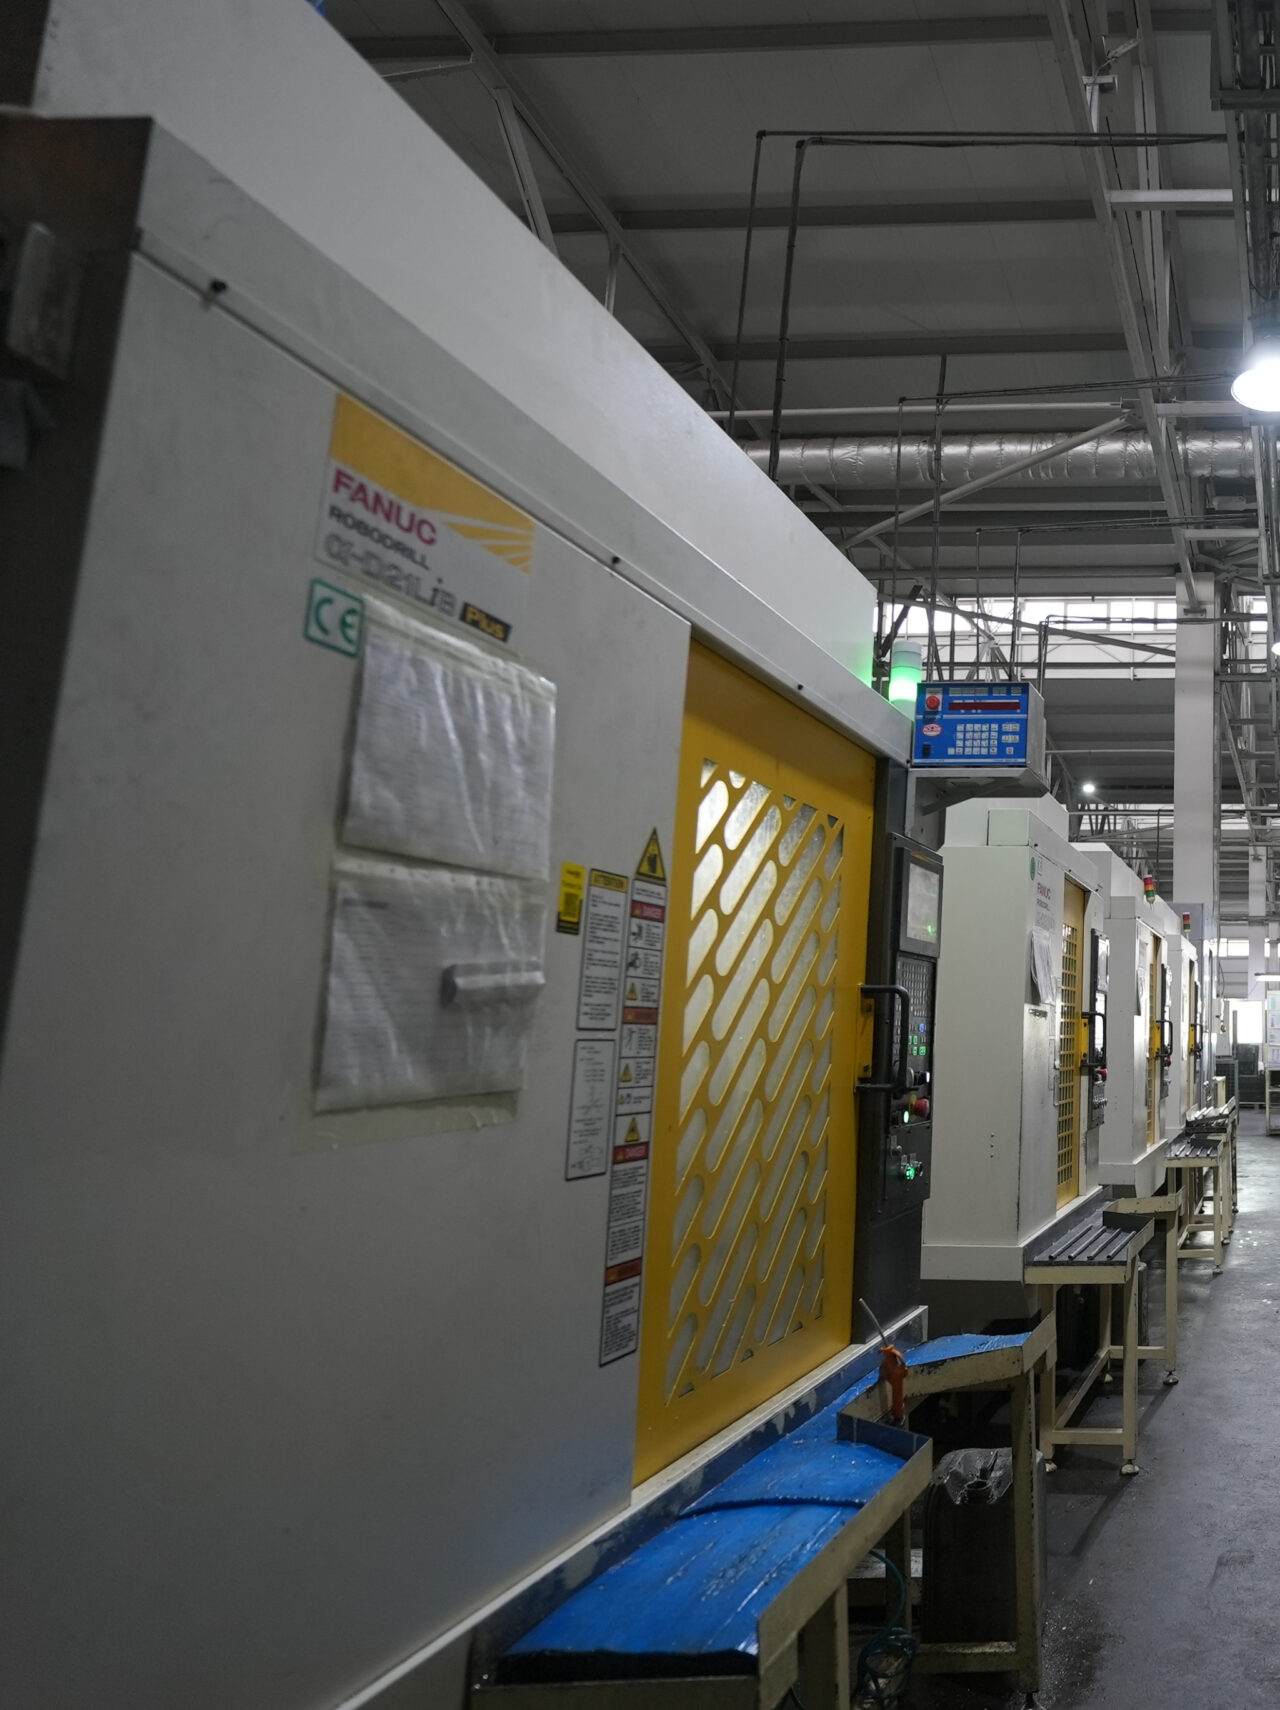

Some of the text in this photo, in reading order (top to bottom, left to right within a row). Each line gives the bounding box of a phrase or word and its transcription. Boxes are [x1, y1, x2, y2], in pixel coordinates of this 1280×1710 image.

[332, 468, 437, 546] FANUC
[328, 504, 430, 571] ROBODRILL
[314, 596, 360, 645] CE
[465, 604, 506, 641] Plus
